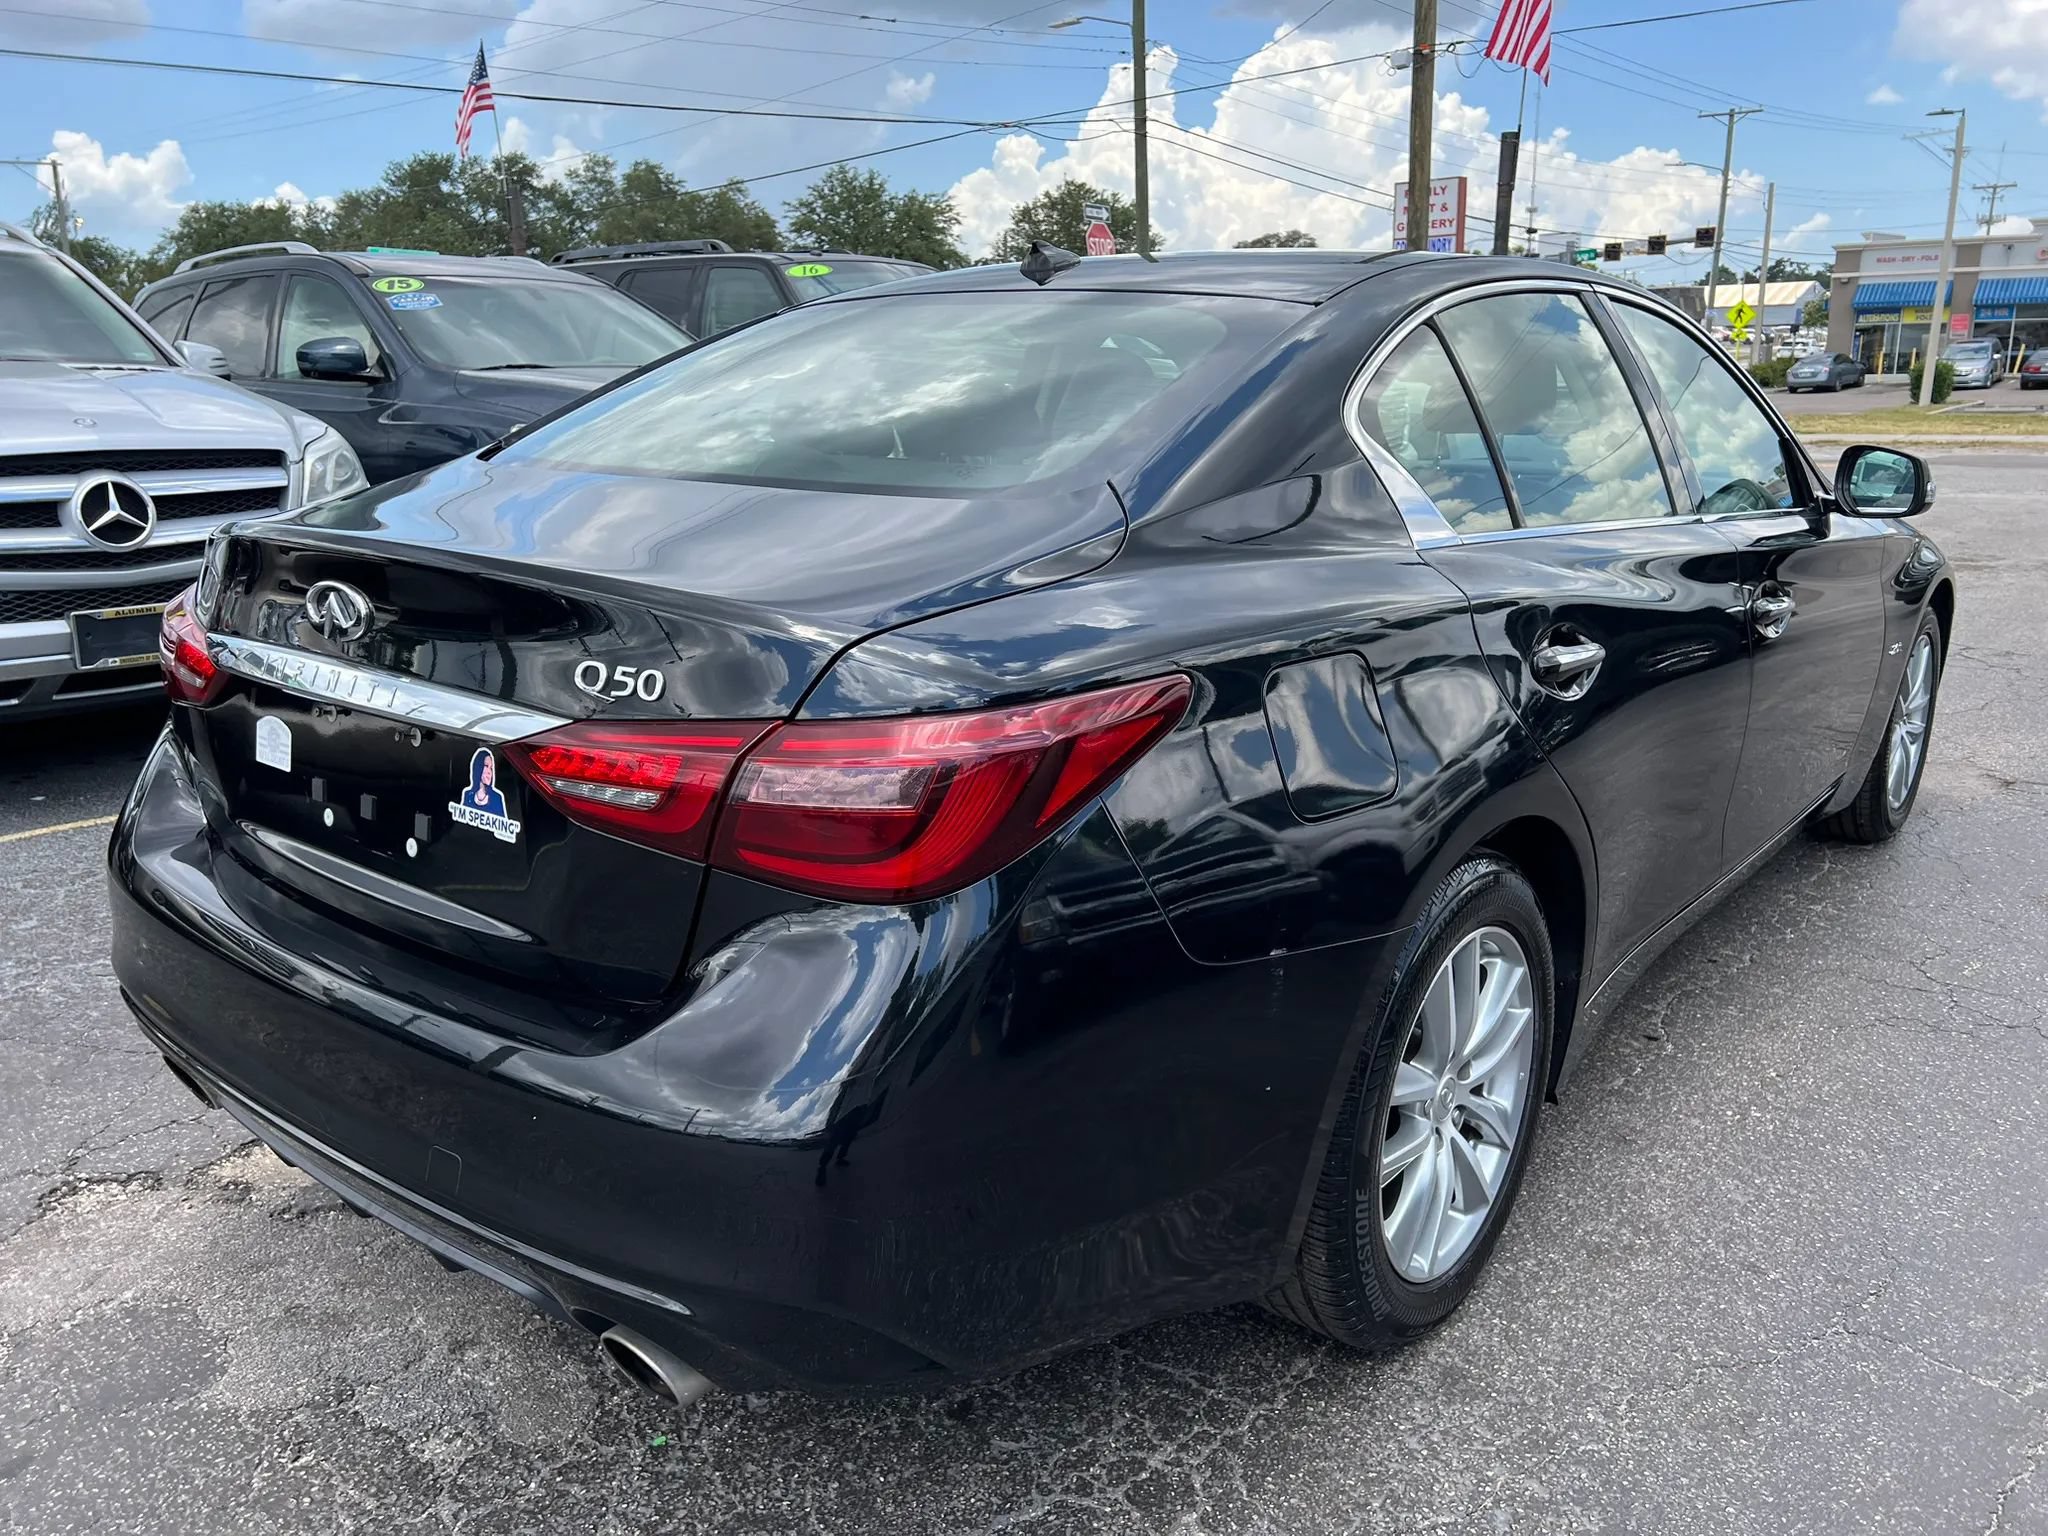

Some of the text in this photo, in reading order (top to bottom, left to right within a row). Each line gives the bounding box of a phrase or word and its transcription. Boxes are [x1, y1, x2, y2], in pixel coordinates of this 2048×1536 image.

[1440, 202, 1449, 212] &
[1396, 218, 1454, 231] GERY
[1089, 238, 1113, 255] STOP
[802, 265, 818, 275] 16
[384, 279, 413, 290] 15
[114, 606, 157, 617] ALUMNI
[262, 653, 398, 707] INFINITI
[574, 660, 666, 704] Q50
